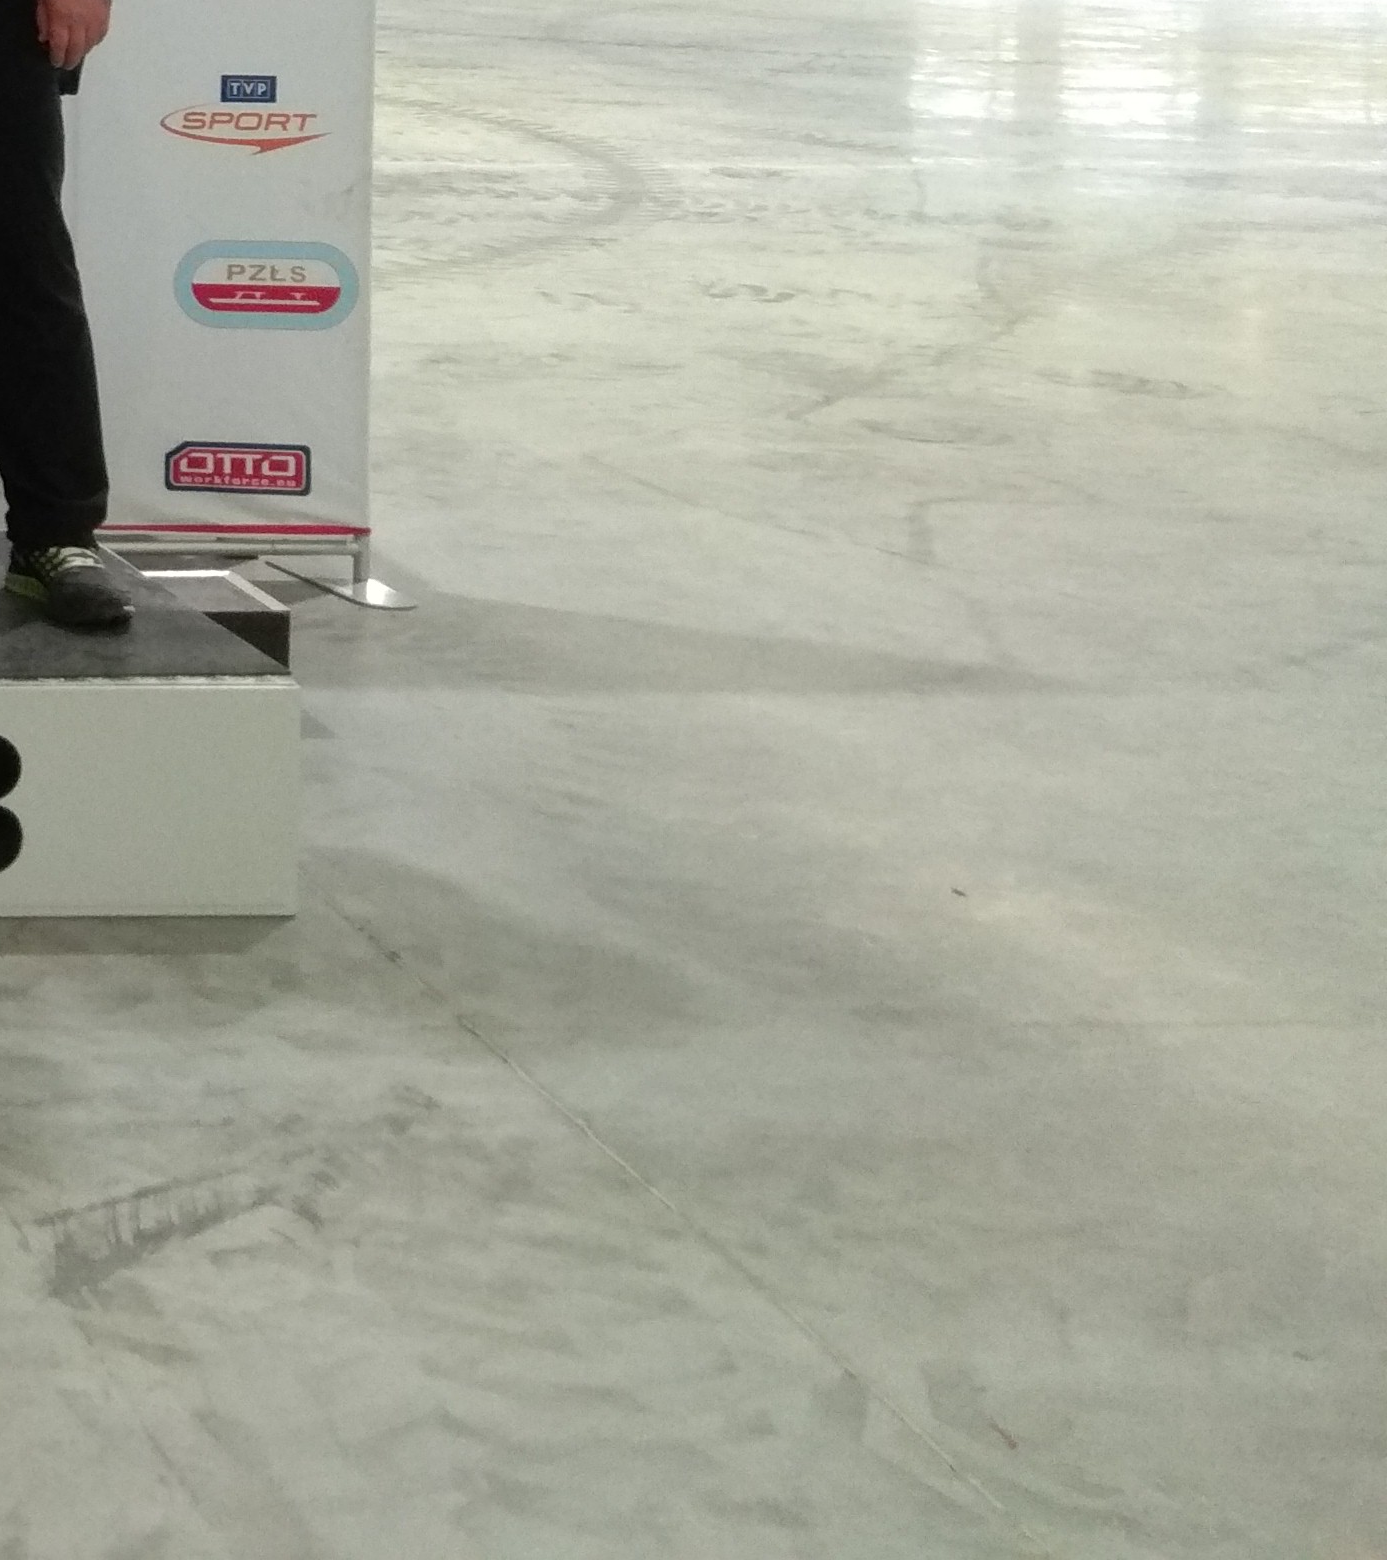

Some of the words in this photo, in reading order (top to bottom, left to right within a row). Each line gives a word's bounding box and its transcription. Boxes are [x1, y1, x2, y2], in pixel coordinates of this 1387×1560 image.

[229, 82, 267, 96] TVP
[182, 111, 317, 132] SPORT
[227, 264, 307, 283] PZŁS
[180, 452, 296, 477] OTTO
[180, 475, 297, 487] workforce.eu
